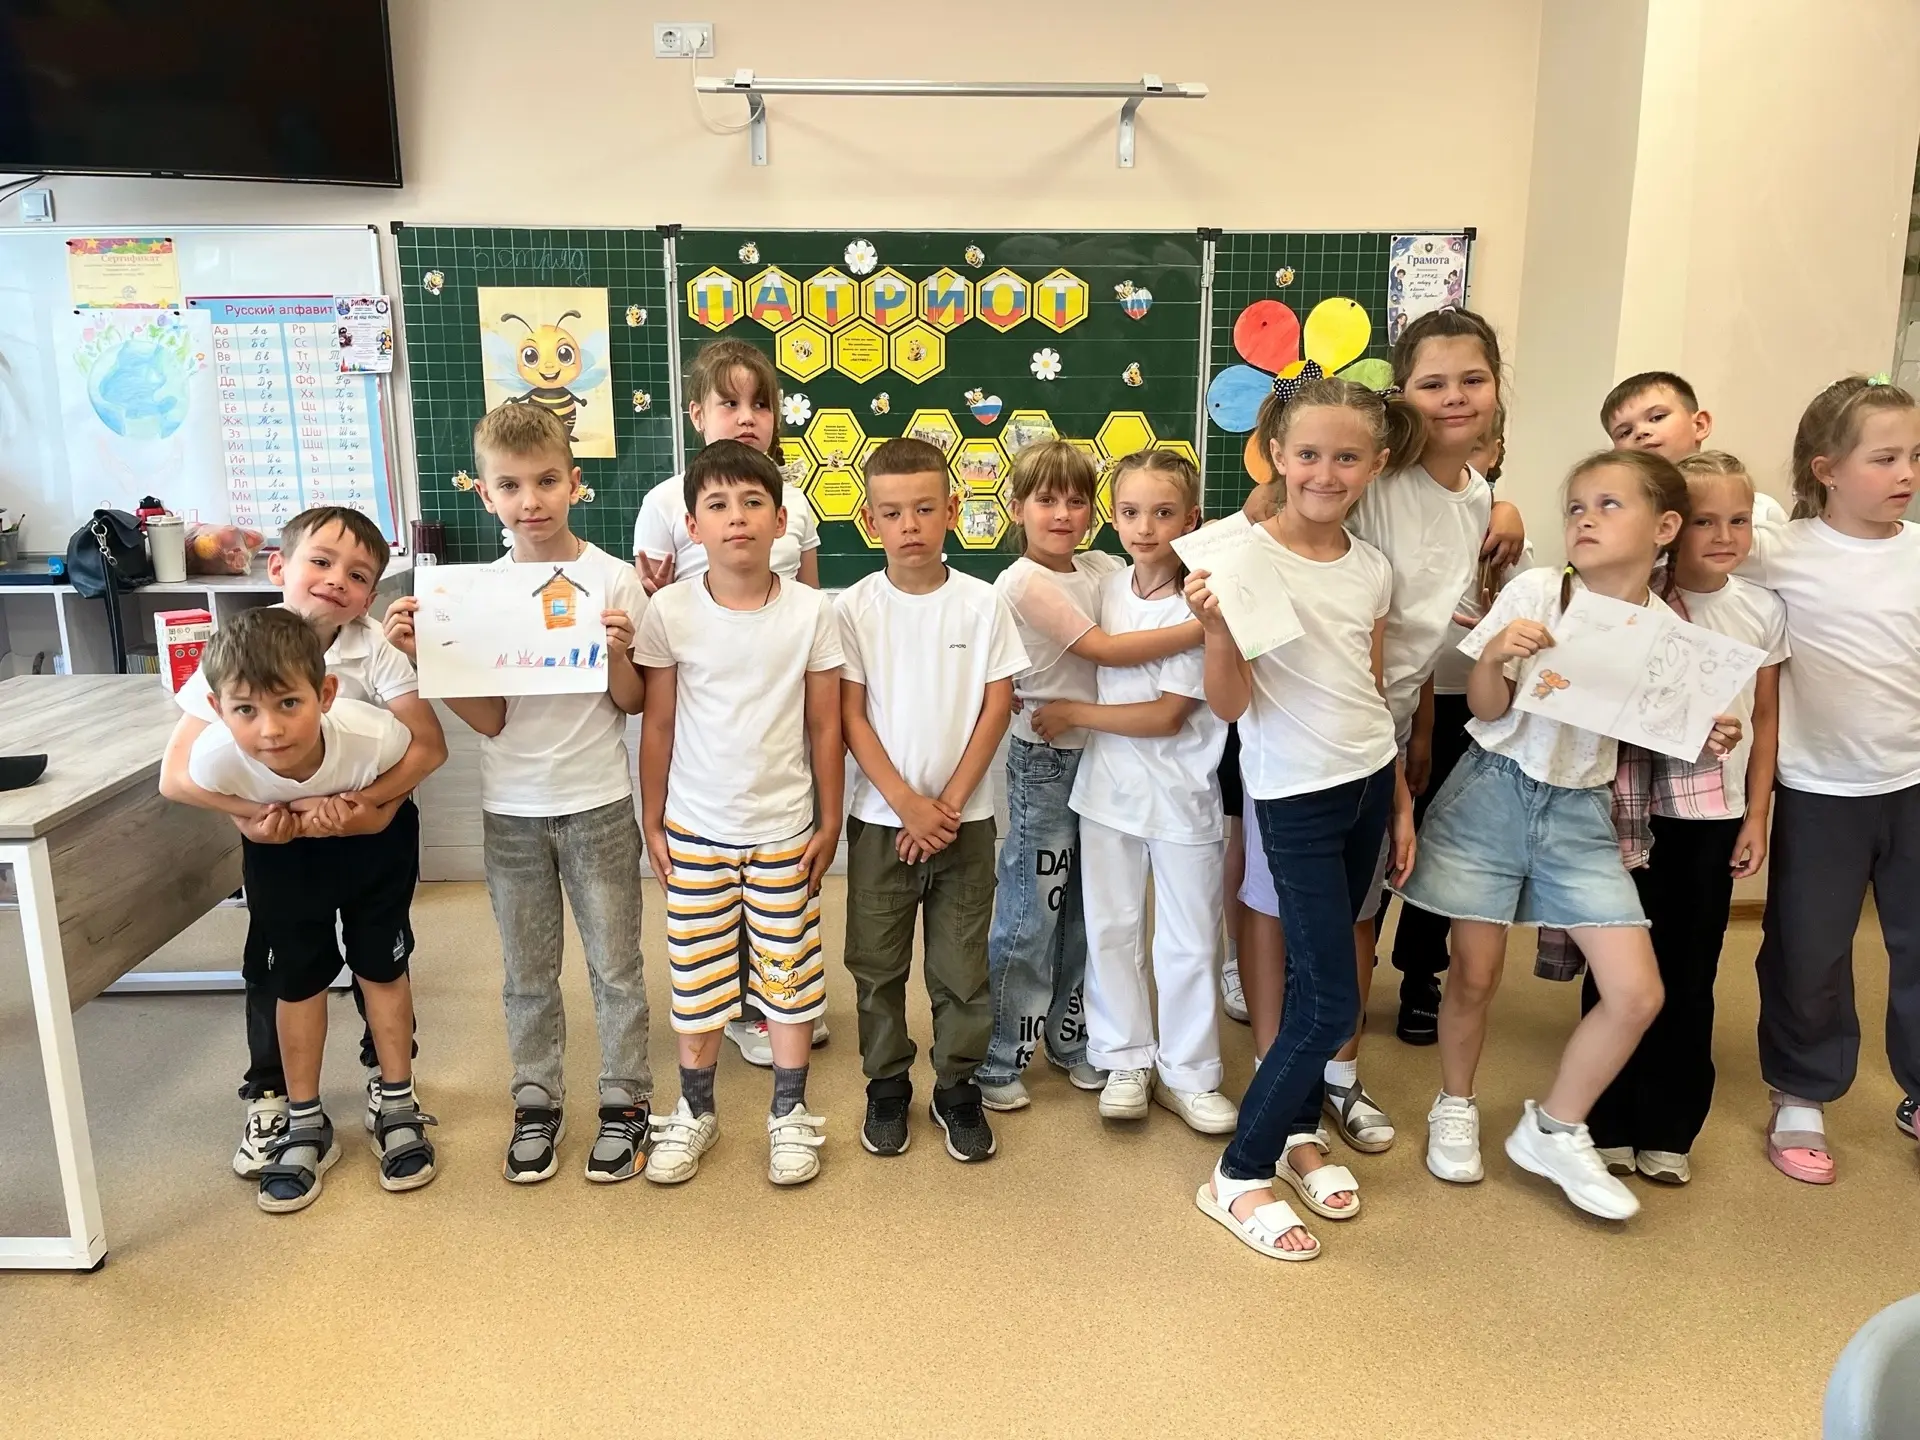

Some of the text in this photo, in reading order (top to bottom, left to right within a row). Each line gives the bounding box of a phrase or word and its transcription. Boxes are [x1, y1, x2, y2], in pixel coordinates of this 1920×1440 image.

[101, 254, 160, 263] Сертификат
[1407, 254, 1450, 266] Грамота
[697, 271, 1079, 326] ПАТРИОТ
[225, 304, 333, 318] Русский алфавит
[214, 326, 228, 335] Аа
[292, 324, 305, 335] Рр
[216, 339, 229, 348] Бб
[295, 338, 307, 347] Сс
[218, 352, 230, 361] Вв
[297, 351, 308, 360] Тт
[220, 365, 230, 374] Гг
[297, 362, 310, 372] Уу
[220, 377, 236, 387] Дд
[296, 376, 315, 385] Фф
[223, 390, 234, 399] Ее
[301, 389, 315, 398] Хх
[302, 402, 316, 411] Цц
[223, 416, 242, 425] Жж
[304, 414, 317, 423] Чч
[229, 429, 240, 438] Зз
[302, 428, 321, 436] Шш
[303, 440, 323, 450] Щщ
[234, 480, 248, 488] Лл
[232, 492, 251, 500] Мм
[237, 516, 253, 525] Оо
